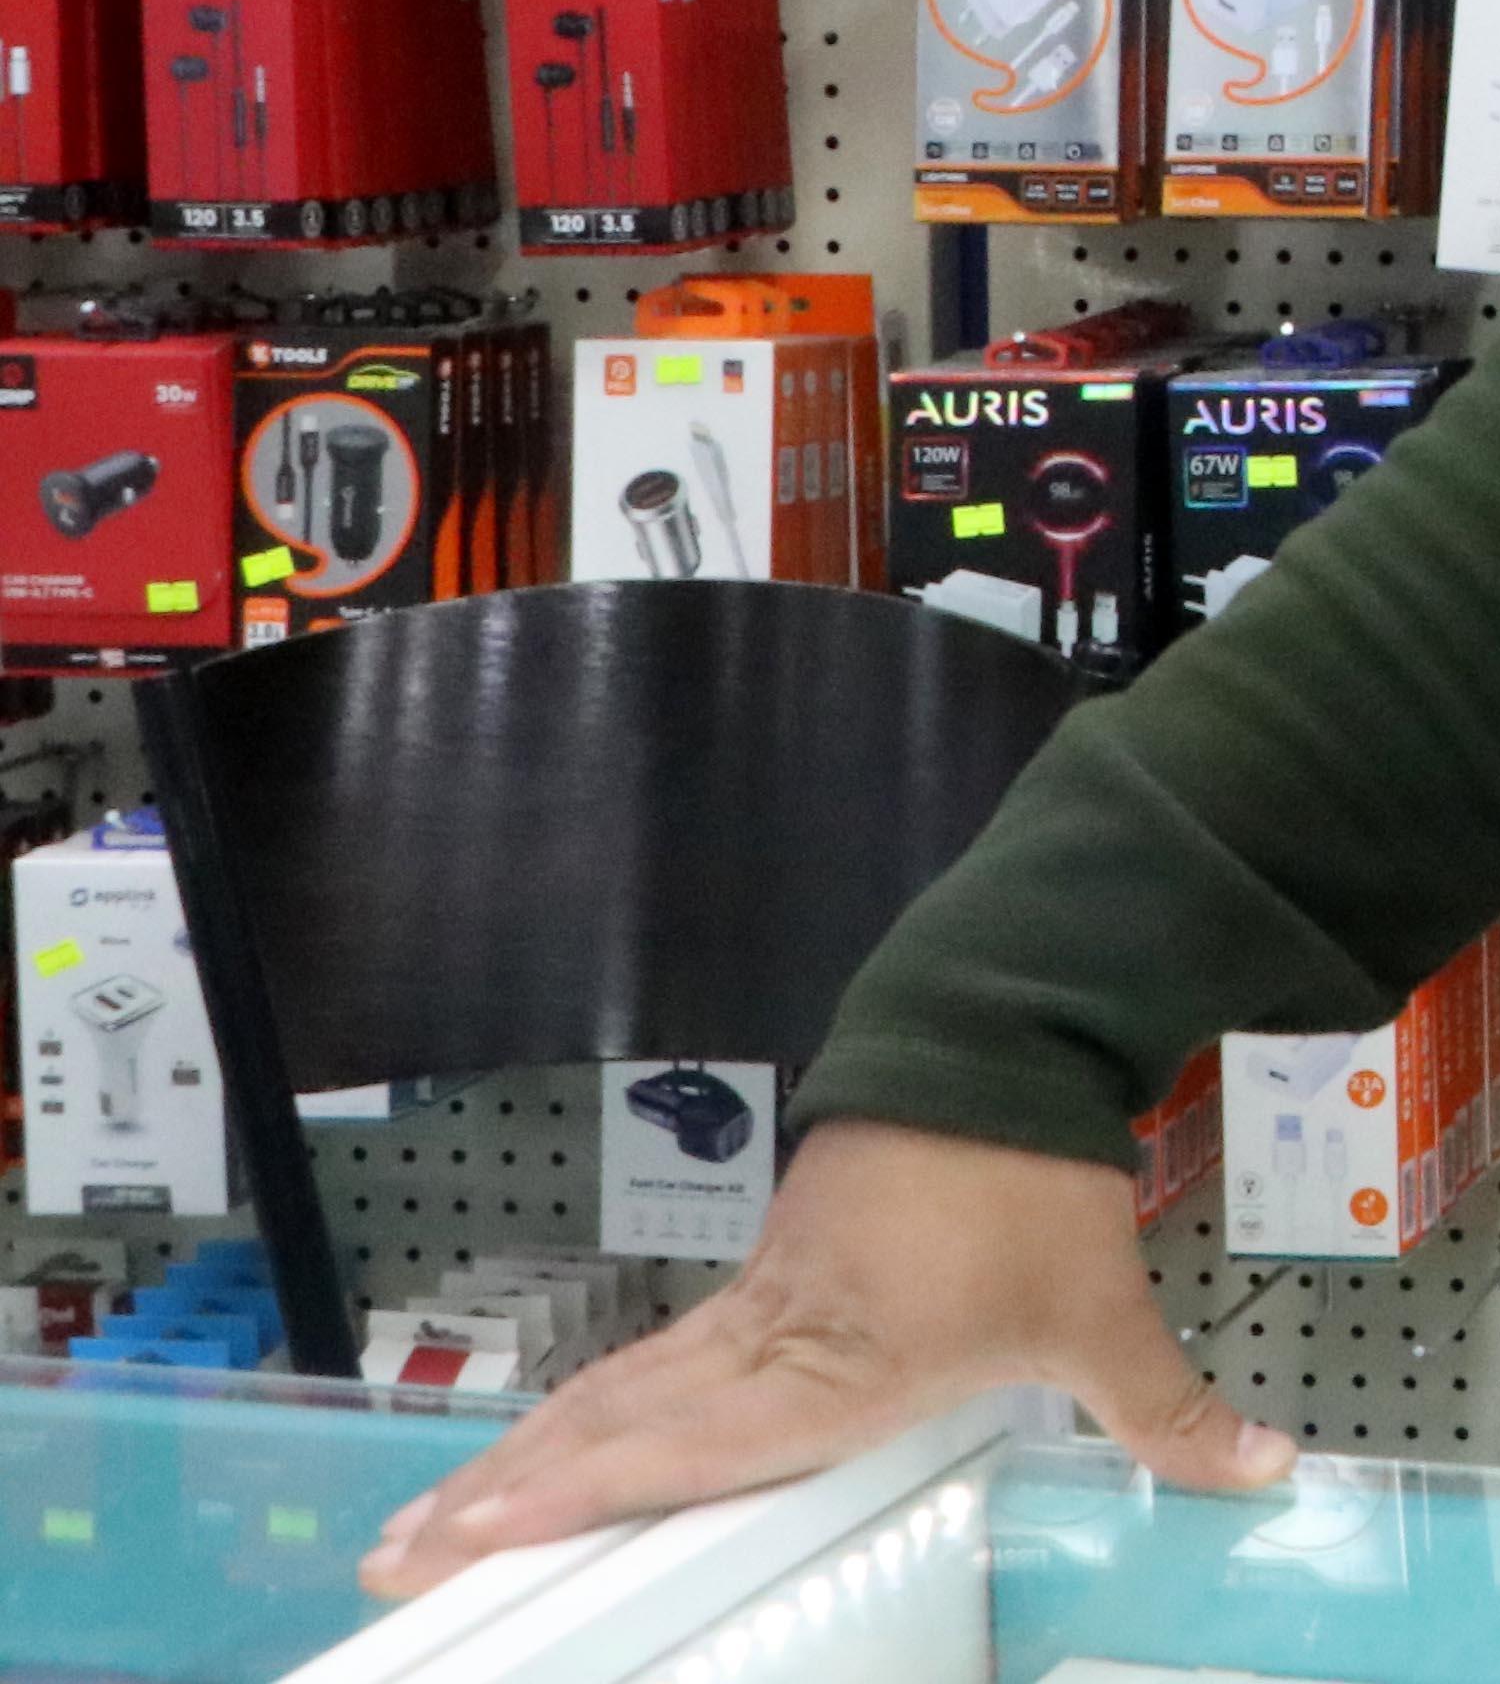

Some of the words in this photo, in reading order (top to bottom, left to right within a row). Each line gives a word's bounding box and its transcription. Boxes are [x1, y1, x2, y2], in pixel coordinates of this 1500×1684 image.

[181, 207, 217, 228] 120
[551, 214, 586, 234] 120
[905, 389, 1050, 427] AURIS
[1183, 397, 1328, 436] AURIS
[912, 445, 962, 463] 120W
[1189, 454, 1239, 476] 67W
